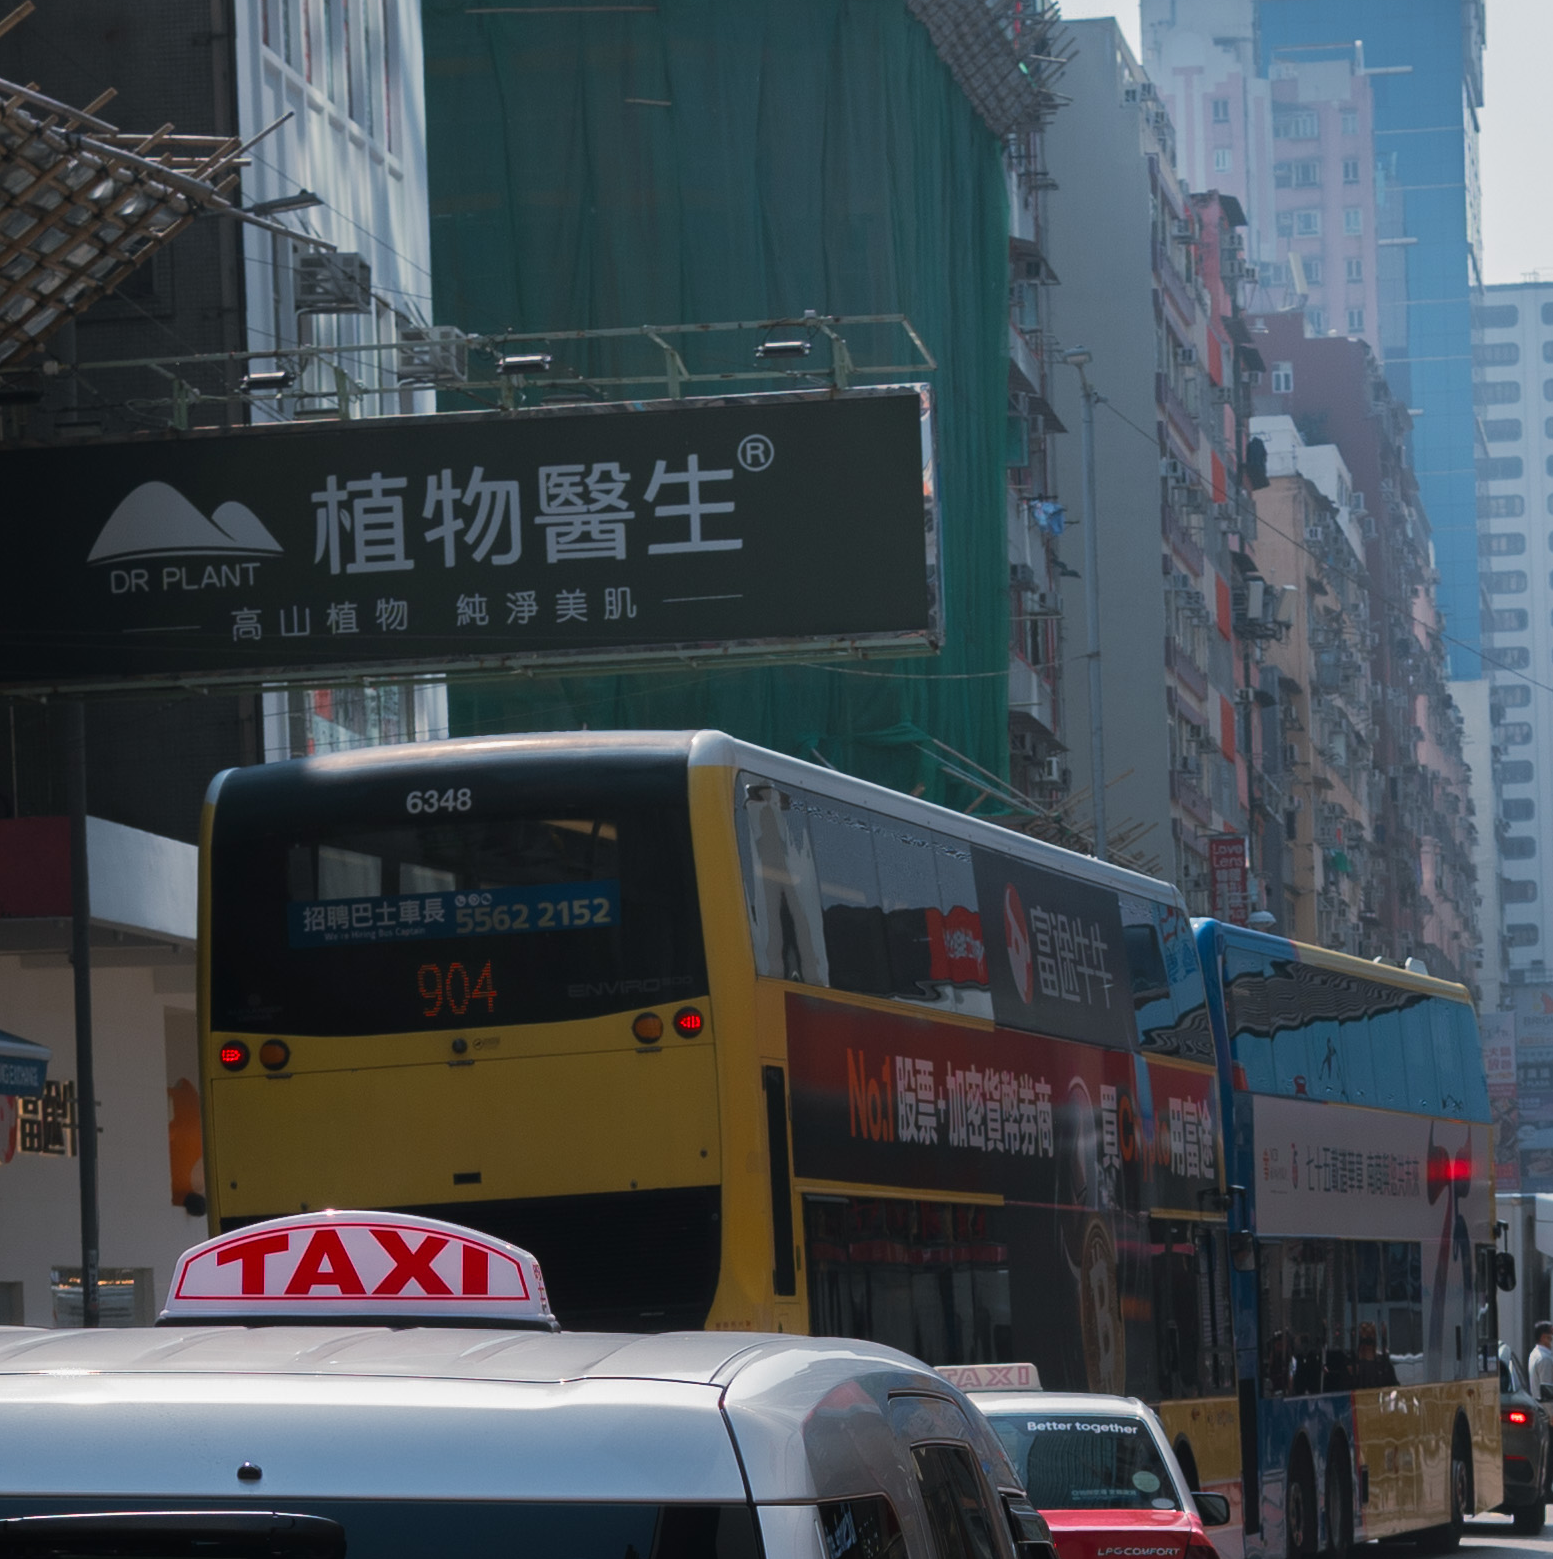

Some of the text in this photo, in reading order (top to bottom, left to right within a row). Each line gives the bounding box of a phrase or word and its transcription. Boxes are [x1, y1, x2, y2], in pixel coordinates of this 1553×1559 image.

[310, 453, 743, 575] 植物醫生
[109, 562, 261, 593] DR PLANT
[231, 586, 638, 641] 高山植物 純淨美肌
[405, 788, 473, 815] 6348
[302, 895, 613, 936] 招聘巴士車長 5562 2152
[417, 959, 498, 1017] 904
[848, 1046, 895, 1142] No.1
[216, 1229, 490, 1296] TAXI
[1027, 1421, 1139, 1437] Better together
